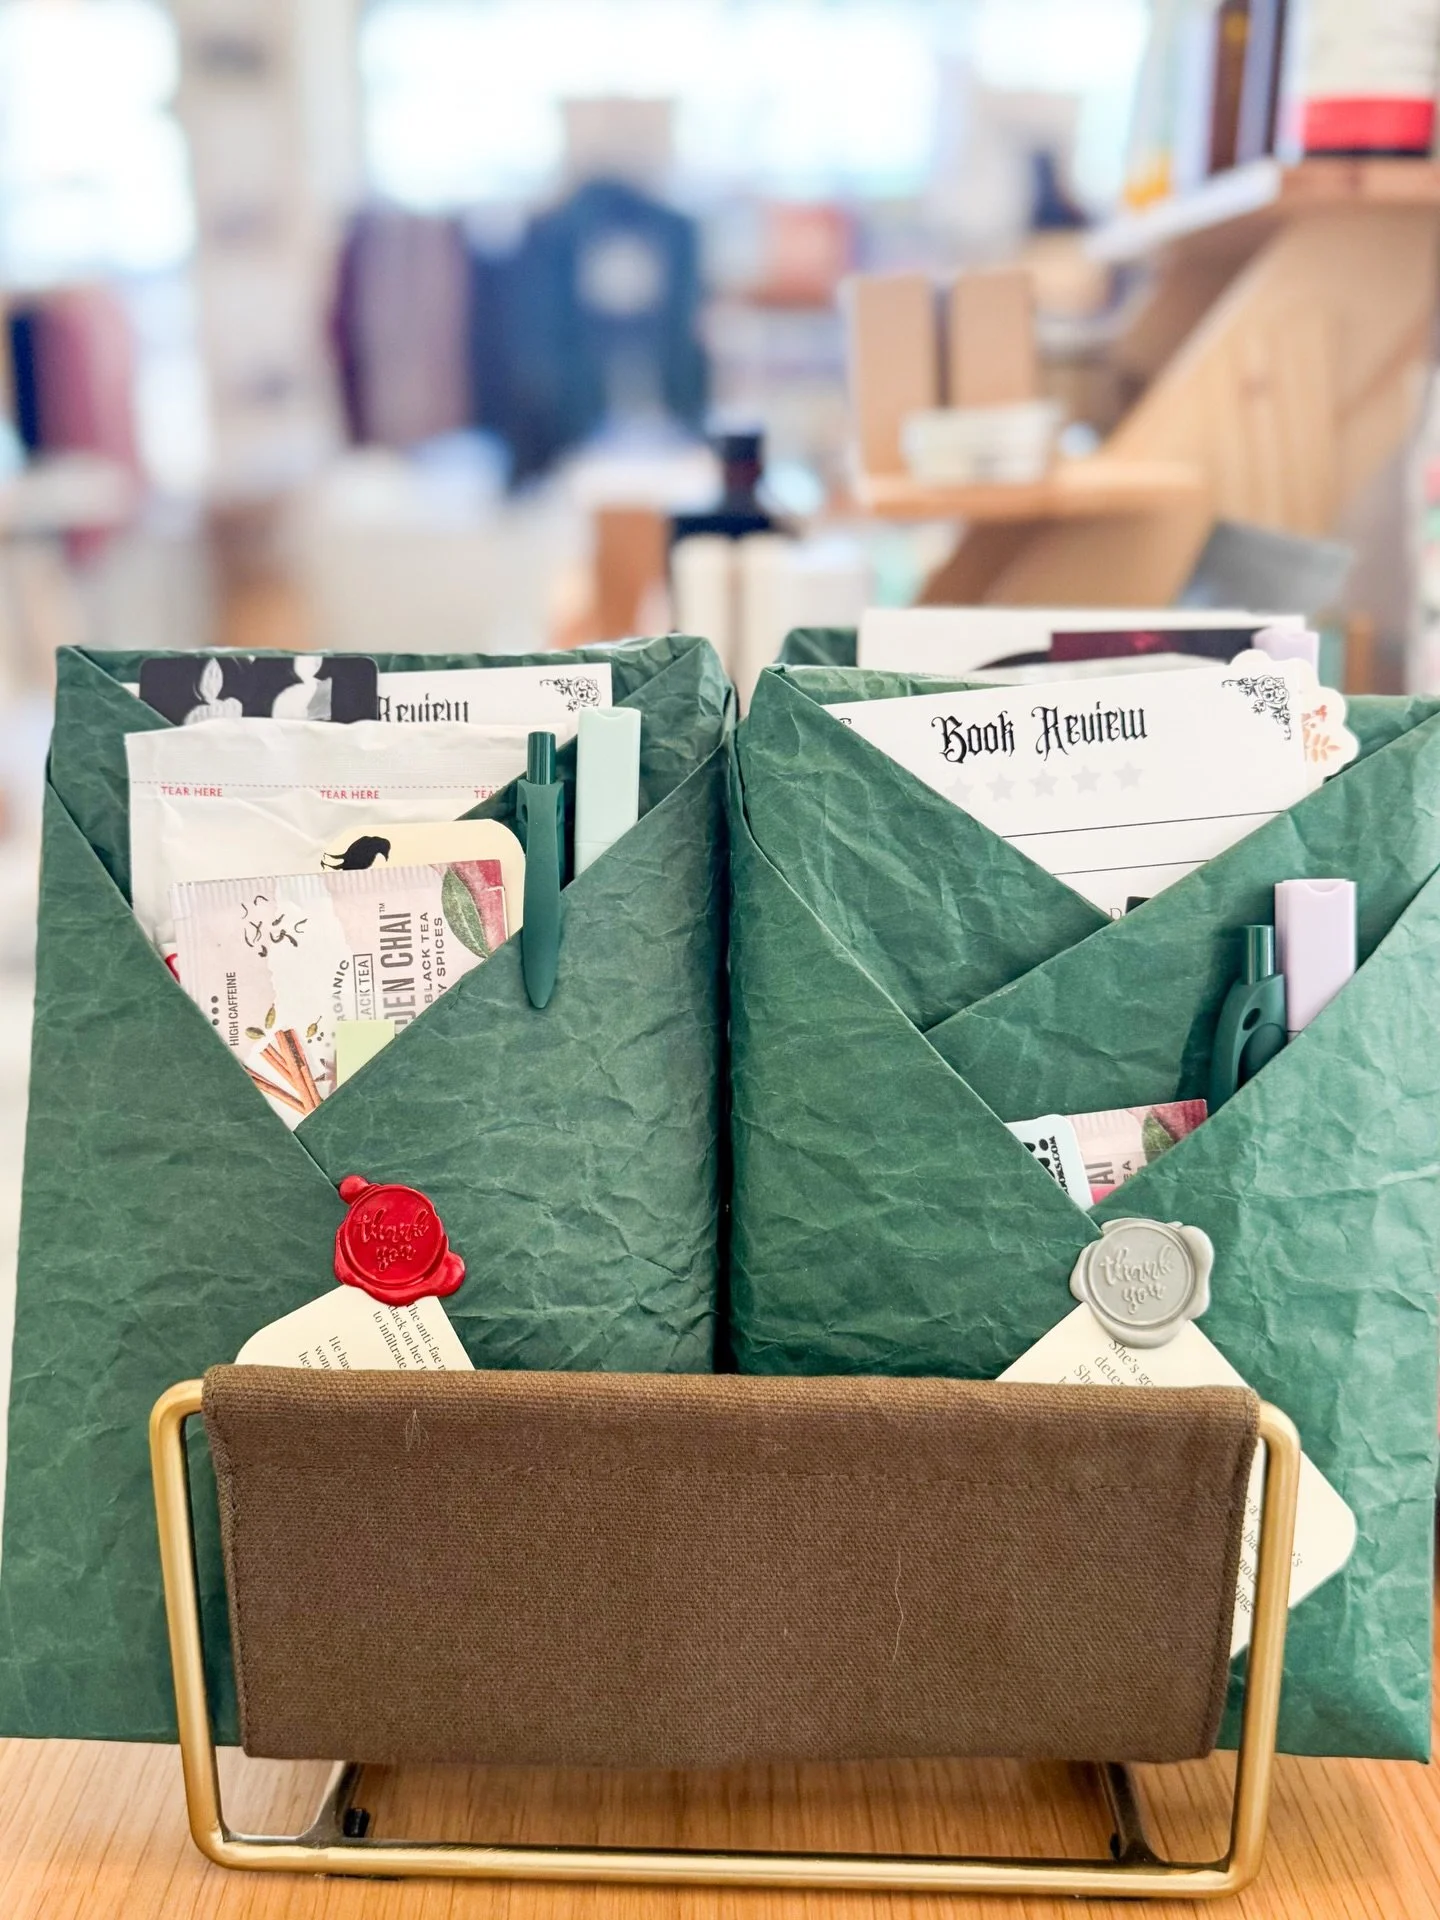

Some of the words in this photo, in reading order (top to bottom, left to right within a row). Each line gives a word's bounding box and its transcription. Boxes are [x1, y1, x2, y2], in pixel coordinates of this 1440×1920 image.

[931, 710, 1016, 764] Book
[1030, 700, 1149, 761] Review
[160, 786, 190, 796] TEAR
[194, 787, 223, 798] HERE
[319, 789, 348, 799] TEAR
[351, 790, 380, 800] HERE
[419, 911, 431, 944] TEA
[433, 916, 447, 977] SPICES
[358, 959, 371, 986] TEA
[421, 948, 435, 1004] BLACK
[225, 971, 238, 1020] CAFFEINE
[229, 1020, 239, 1047] HIGH
[353, 1207, 431, 1243] thank
[375, 1243, 417, 1272] you
[1100, 1244, 1175, 1286] thank
[1121, 1282, 1167, 1315] you
[329, 1335, 342, 1352] He
[372, 1310, 384, 1324] to
[379, 1322, 408, 1369] infiltrate
[401, 1330, 414, 1347] on
[409, 1344, 425, 1365] her
[416, 1321, 442, 1364] anti-fae
